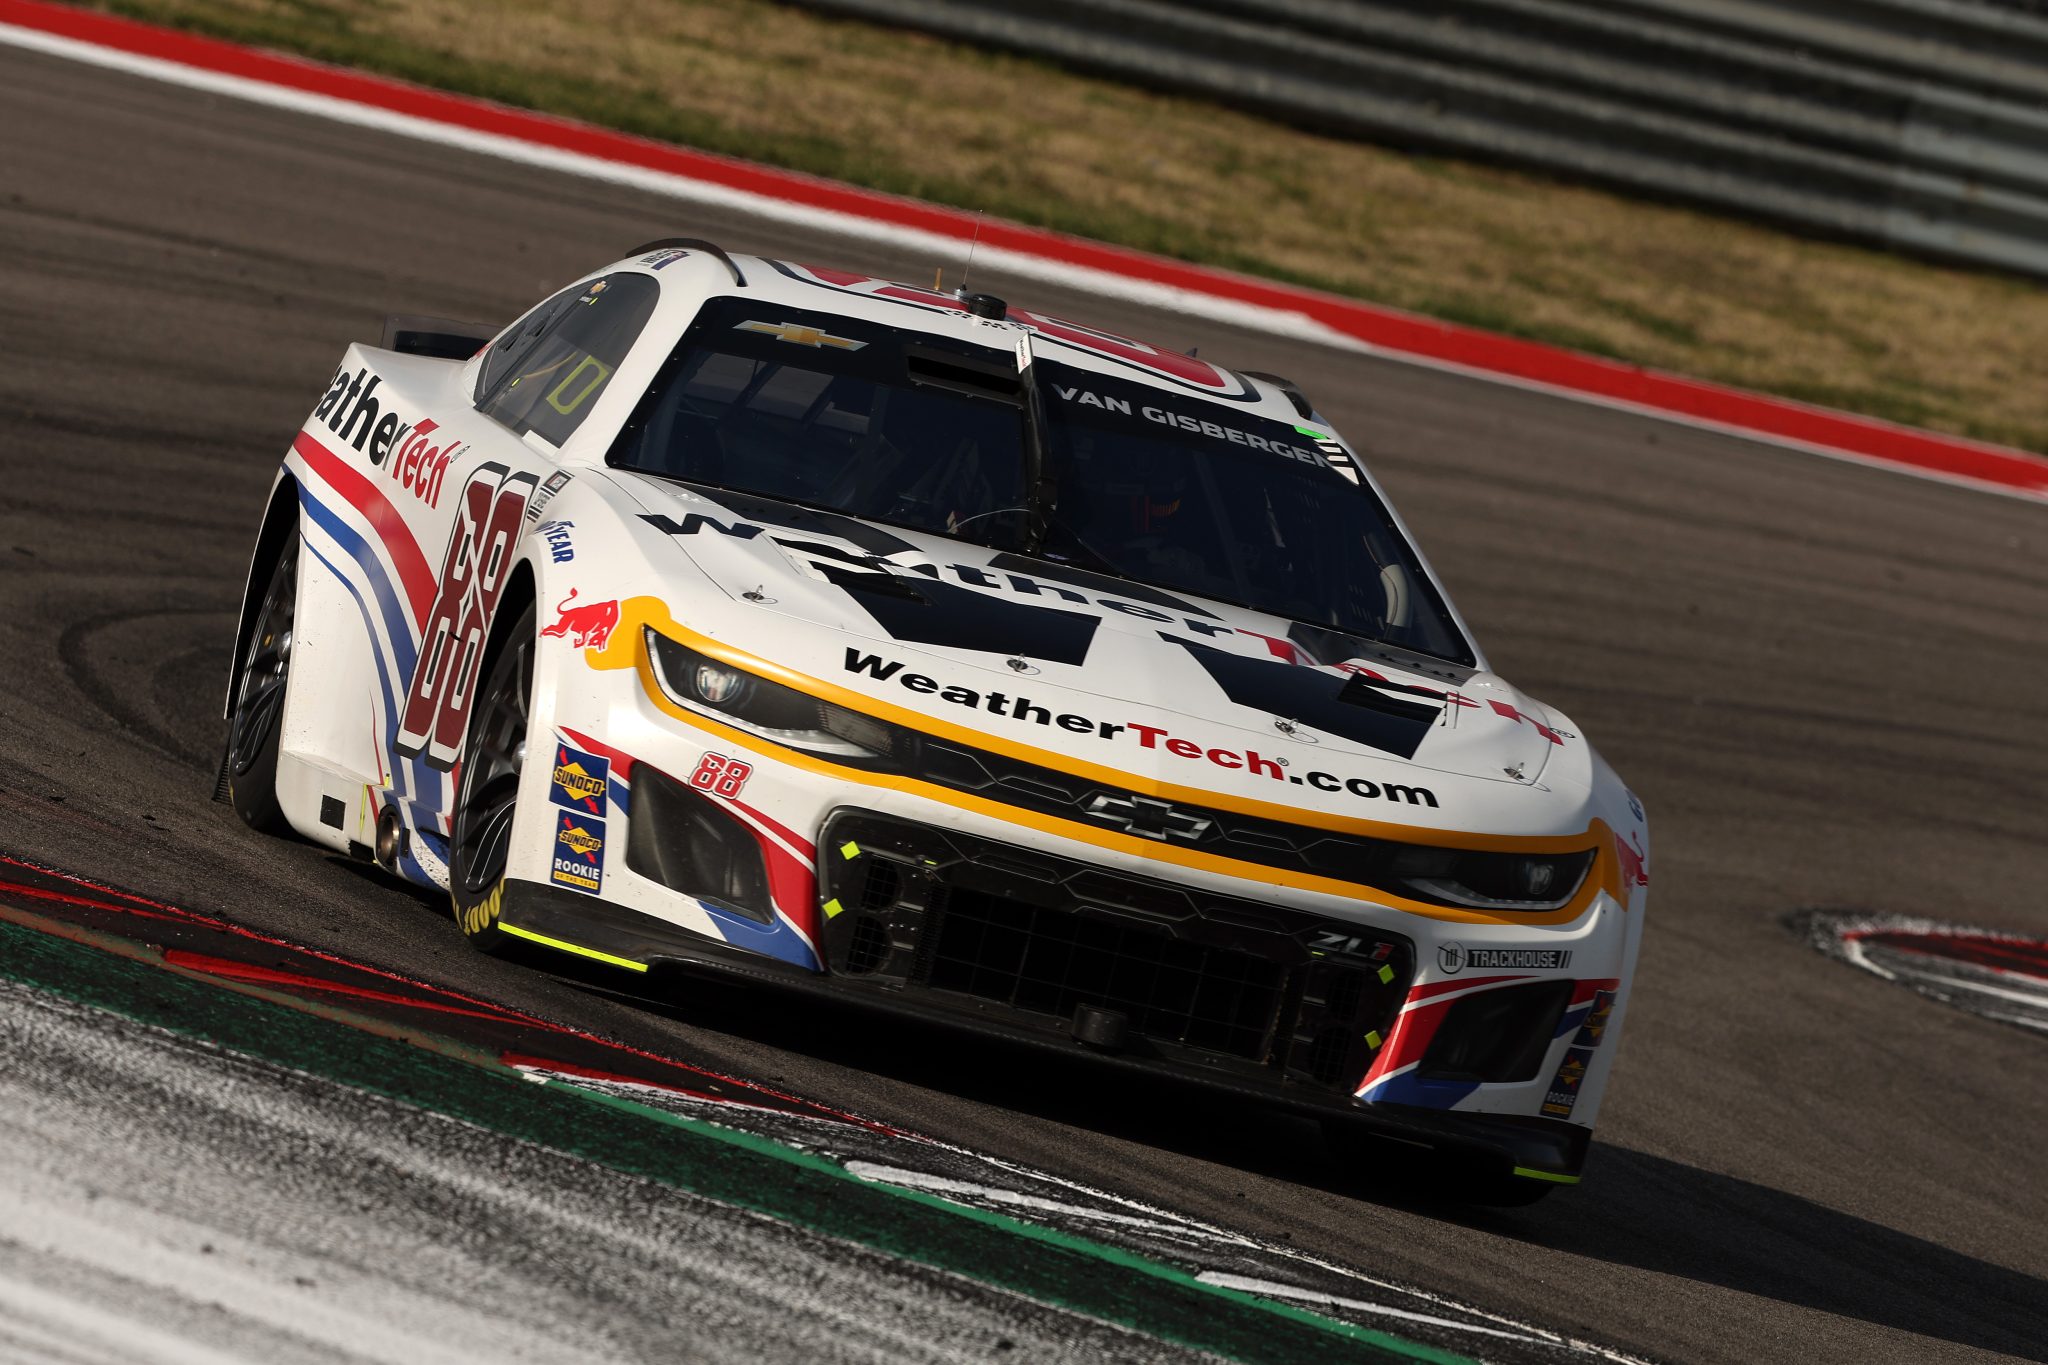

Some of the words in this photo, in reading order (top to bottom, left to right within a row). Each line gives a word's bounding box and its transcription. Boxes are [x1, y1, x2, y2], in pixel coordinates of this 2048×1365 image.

[1051, 383, 1132, 415] VAN
[315, 364, 462, 510] atherTech
[393, 460, 540, 773] 88
[554, 767, 603, 796] SUNOCO
[690, 752, 752, 800] 88
[560, 831, 601, 851] SUNOCO
[554, 857, 600, 880] ROOKIE
[1306, 930, 1394, 961] ZL1
[1471, 950, 1557, 968] TRACKHOUSE
